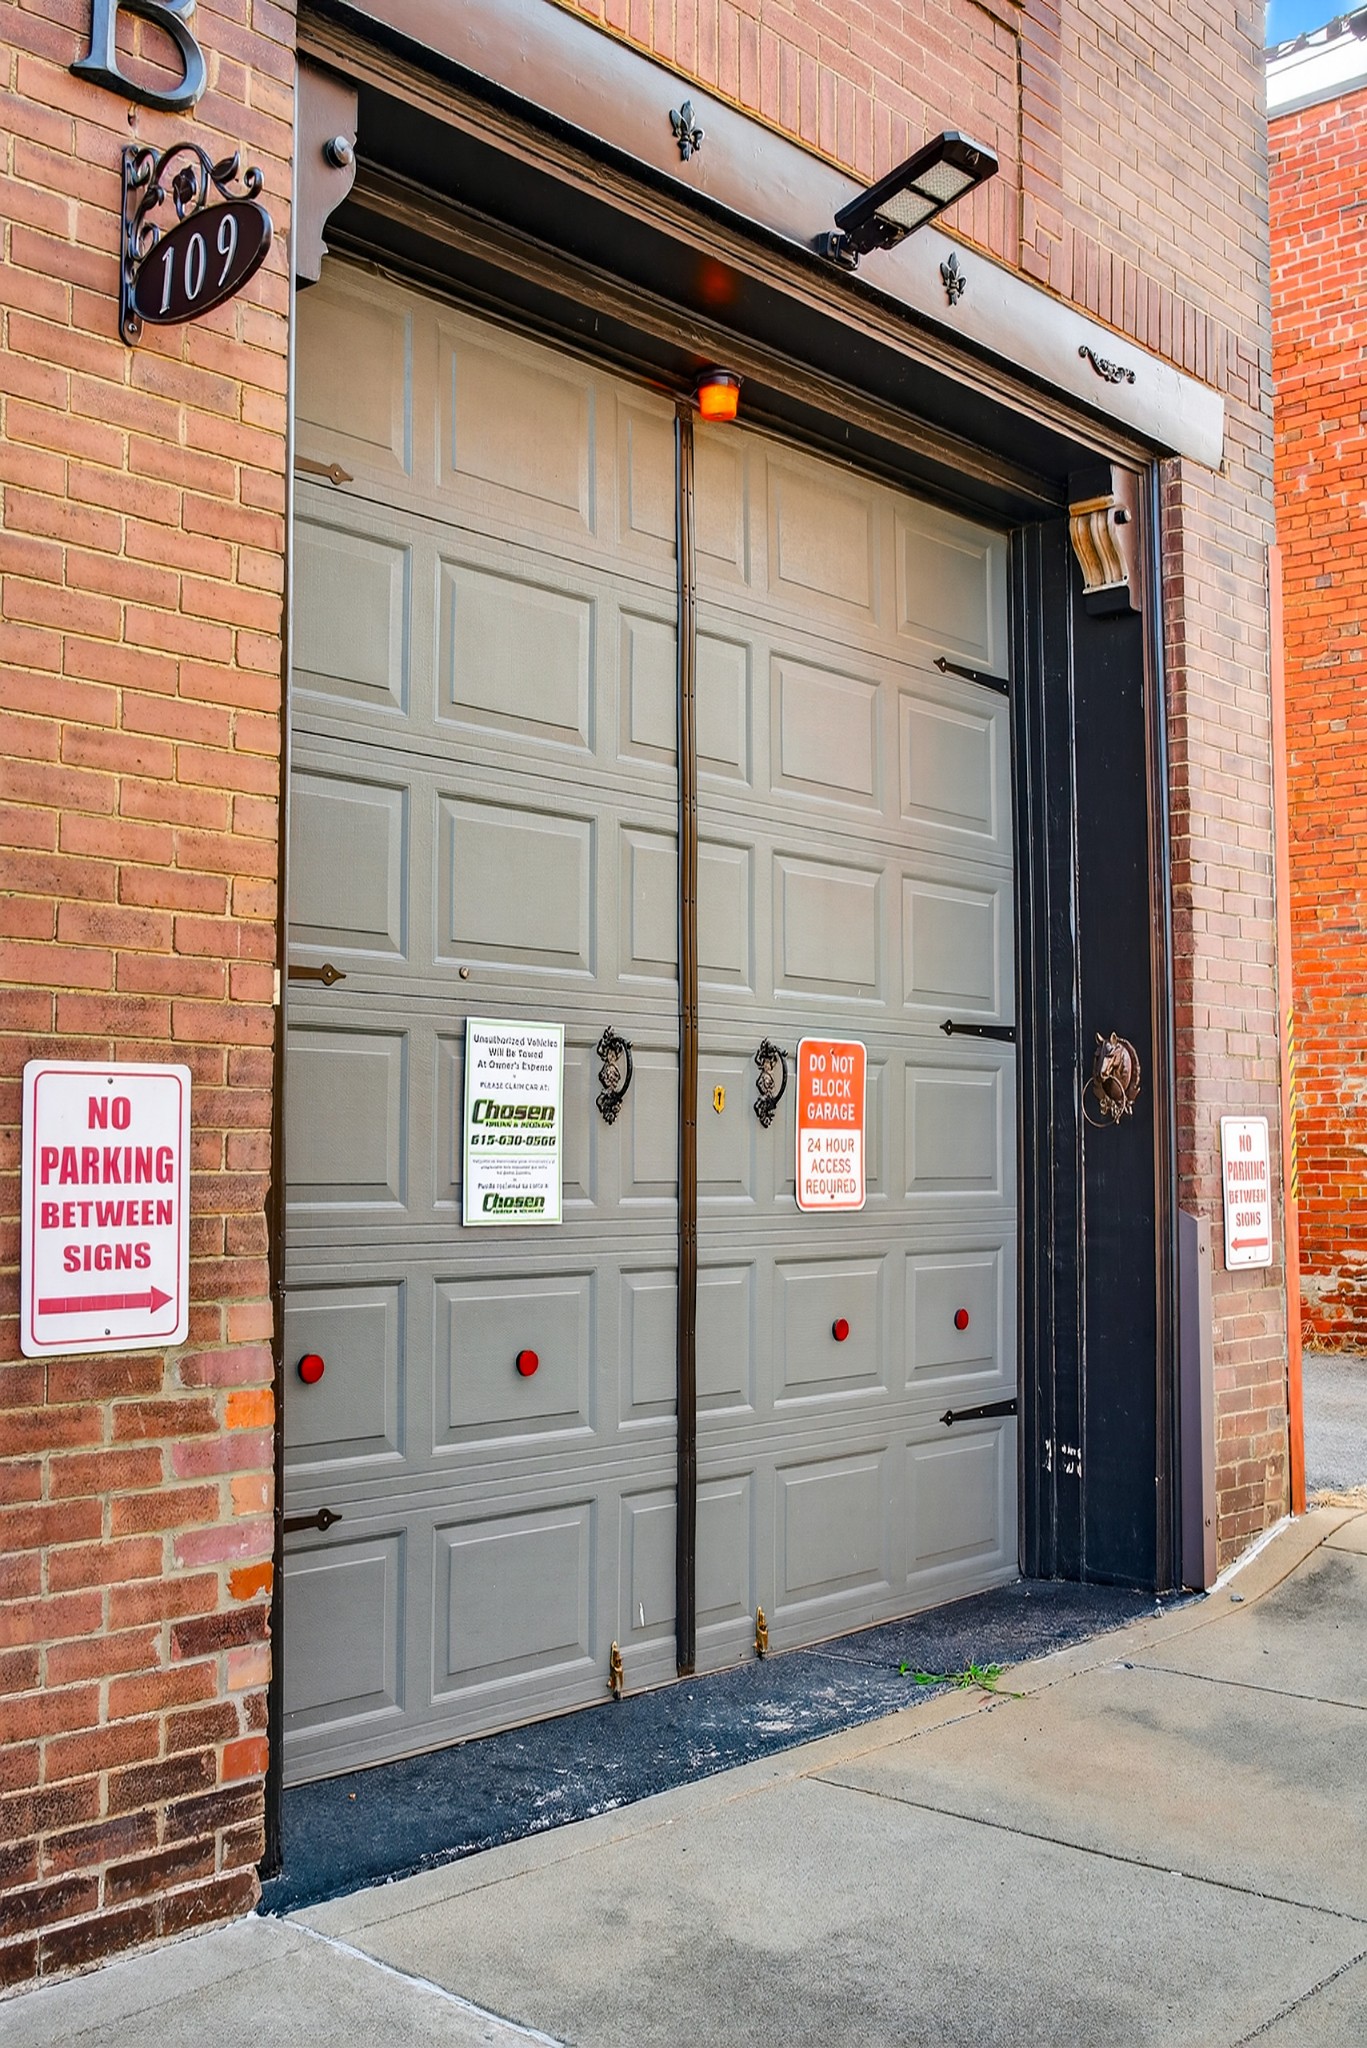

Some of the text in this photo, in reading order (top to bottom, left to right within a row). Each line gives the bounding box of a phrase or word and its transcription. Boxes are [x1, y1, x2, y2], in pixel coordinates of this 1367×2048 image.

[160, 214, 238, 315] 109
[488, 1047, 504, 1057] Will
[477, 1060, 487, 1068] At
[488, 1060, 520, 1070] Owner's
[809, 1054, 855, 1074] DO NOT
[811, 1079, 851, 1097] BLOCK
[88, 1096, 131, 1130] NO
[471, 1098, 556, 1124] Chosen
[807, 1103, 855, 1121] GARAGE
[808, 1138, 855, 1153] 24 HOUR
[1239, 1134, 1252, 1152] NO
[40, 1146, 174, 1185] PARKING
[811, 1158, 851, 1174] ACCESS
[1227, 1160, 1266, 1181] PARKING
[806, 1179, 856, 1195] REQUIRED
[482, 1192, 546, 1212] Chosen
[41, 1199, 173, 1229] BETWEEN
[1235, 1211, 1261, 1227] SIGNS
[63, 1242, 151, 1272] SIGNS
